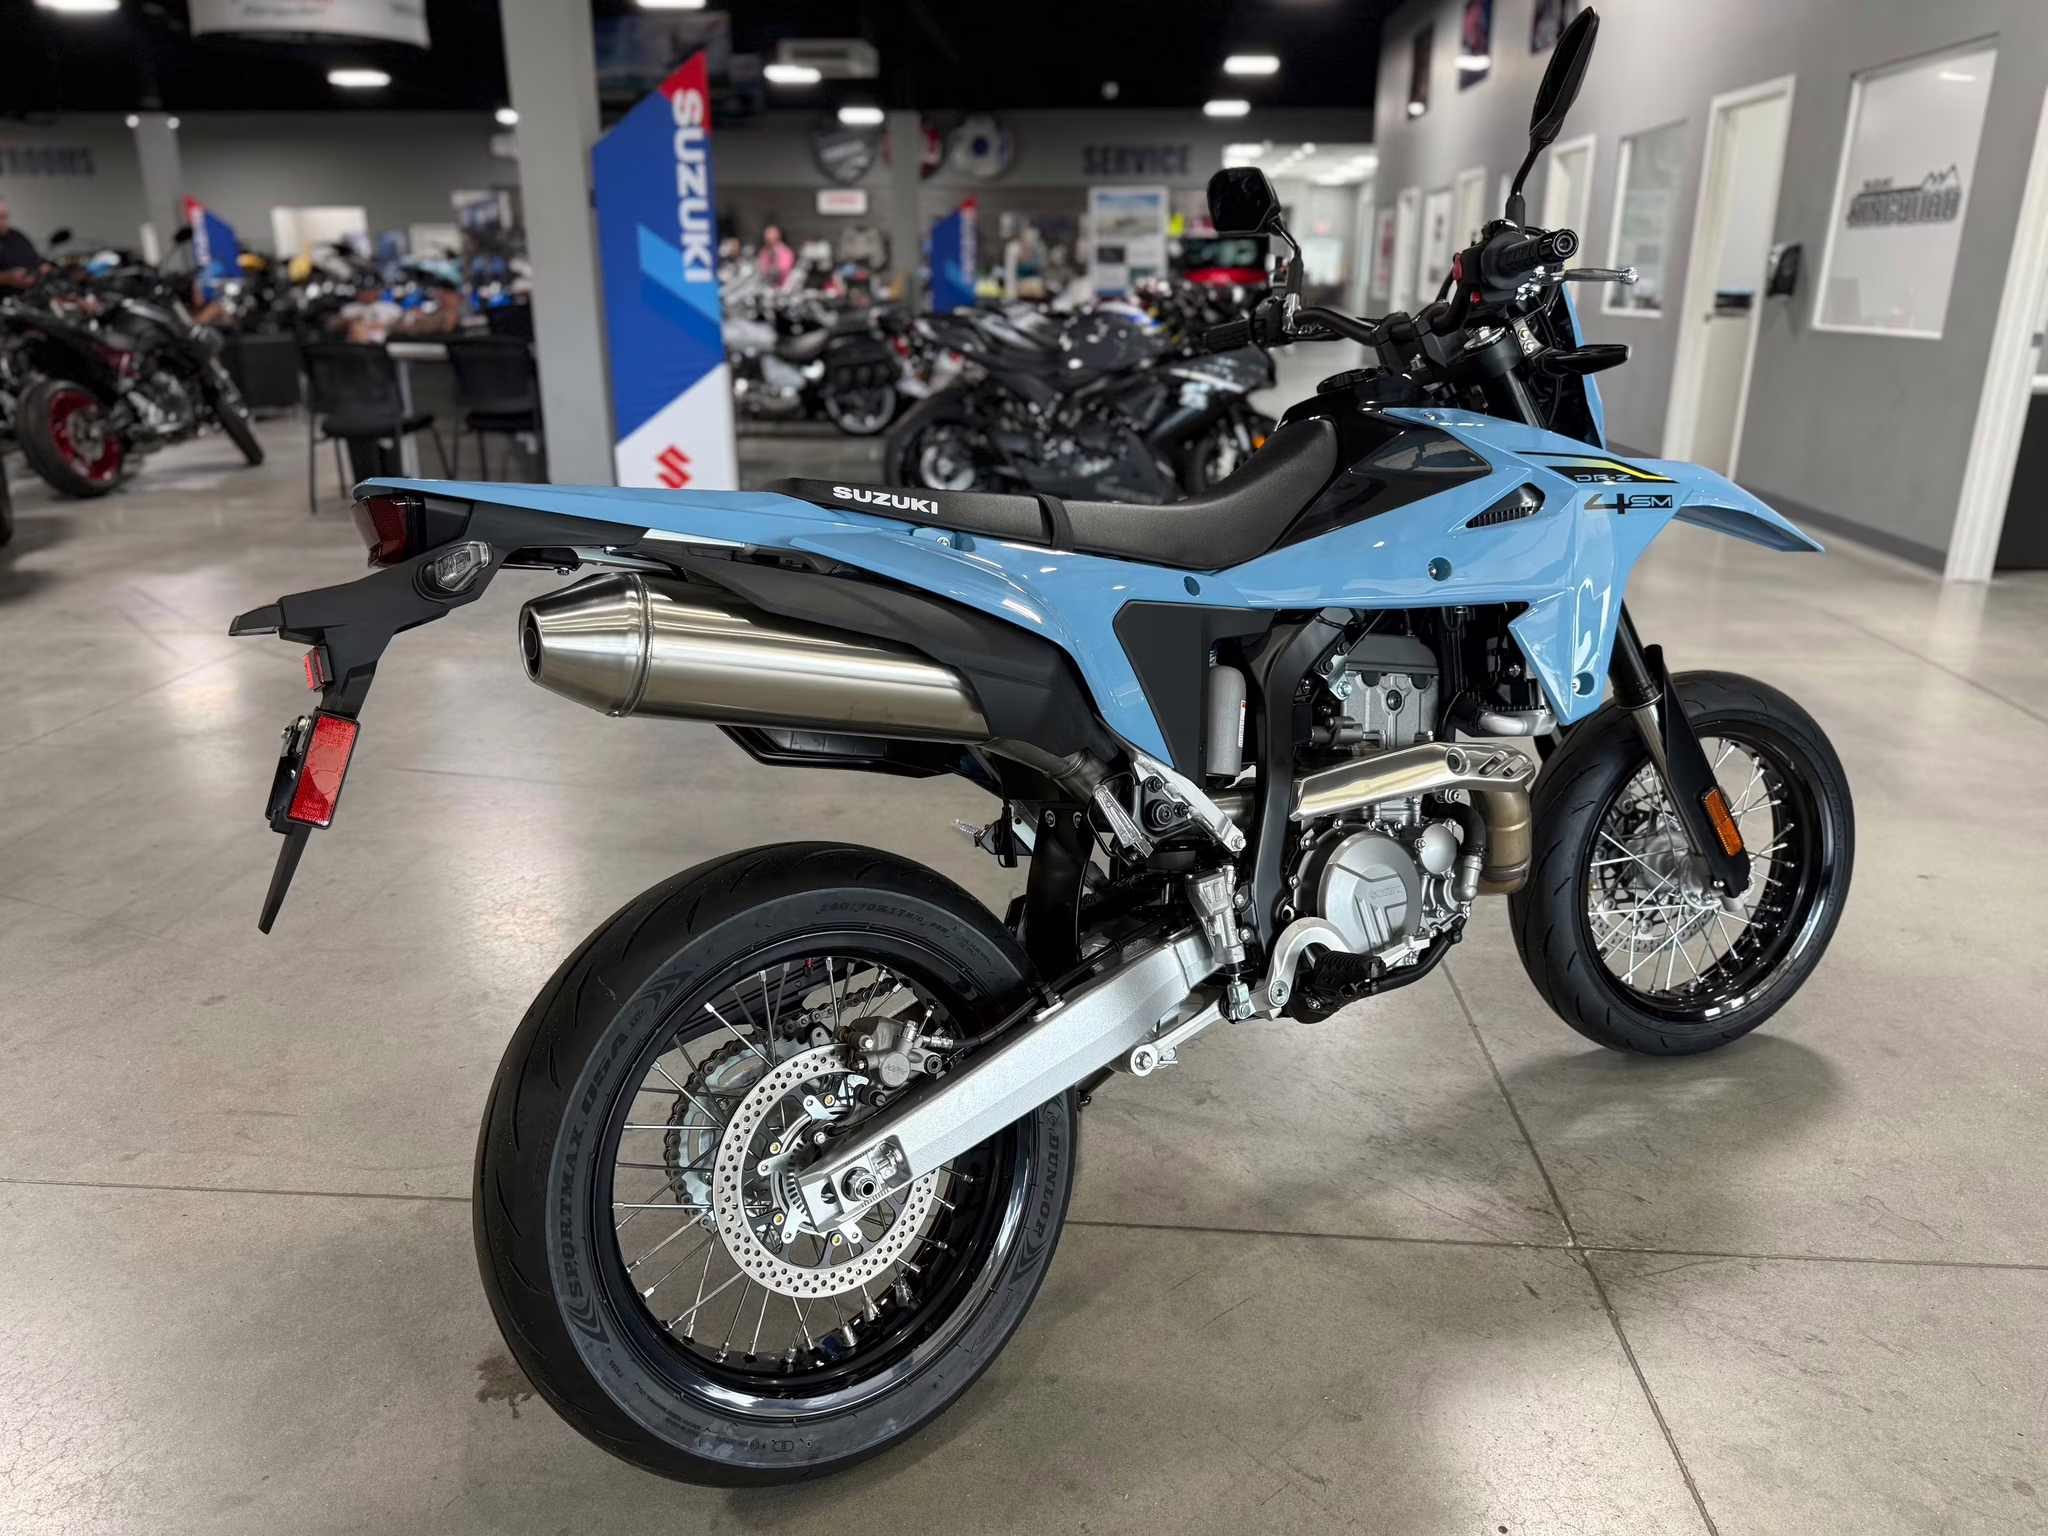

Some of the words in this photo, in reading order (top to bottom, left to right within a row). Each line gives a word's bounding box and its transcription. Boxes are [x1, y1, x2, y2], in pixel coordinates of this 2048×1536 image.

[671, 87, 714, 283] SUZUKI
[833, 486, 939, 515] SUZUKI
[1573, 474, 1633, 482] DR-Z
[560, 1123, 584, 1298] SPORTMAX
[1035, 1133, 1060, 1239] DUNLOP
